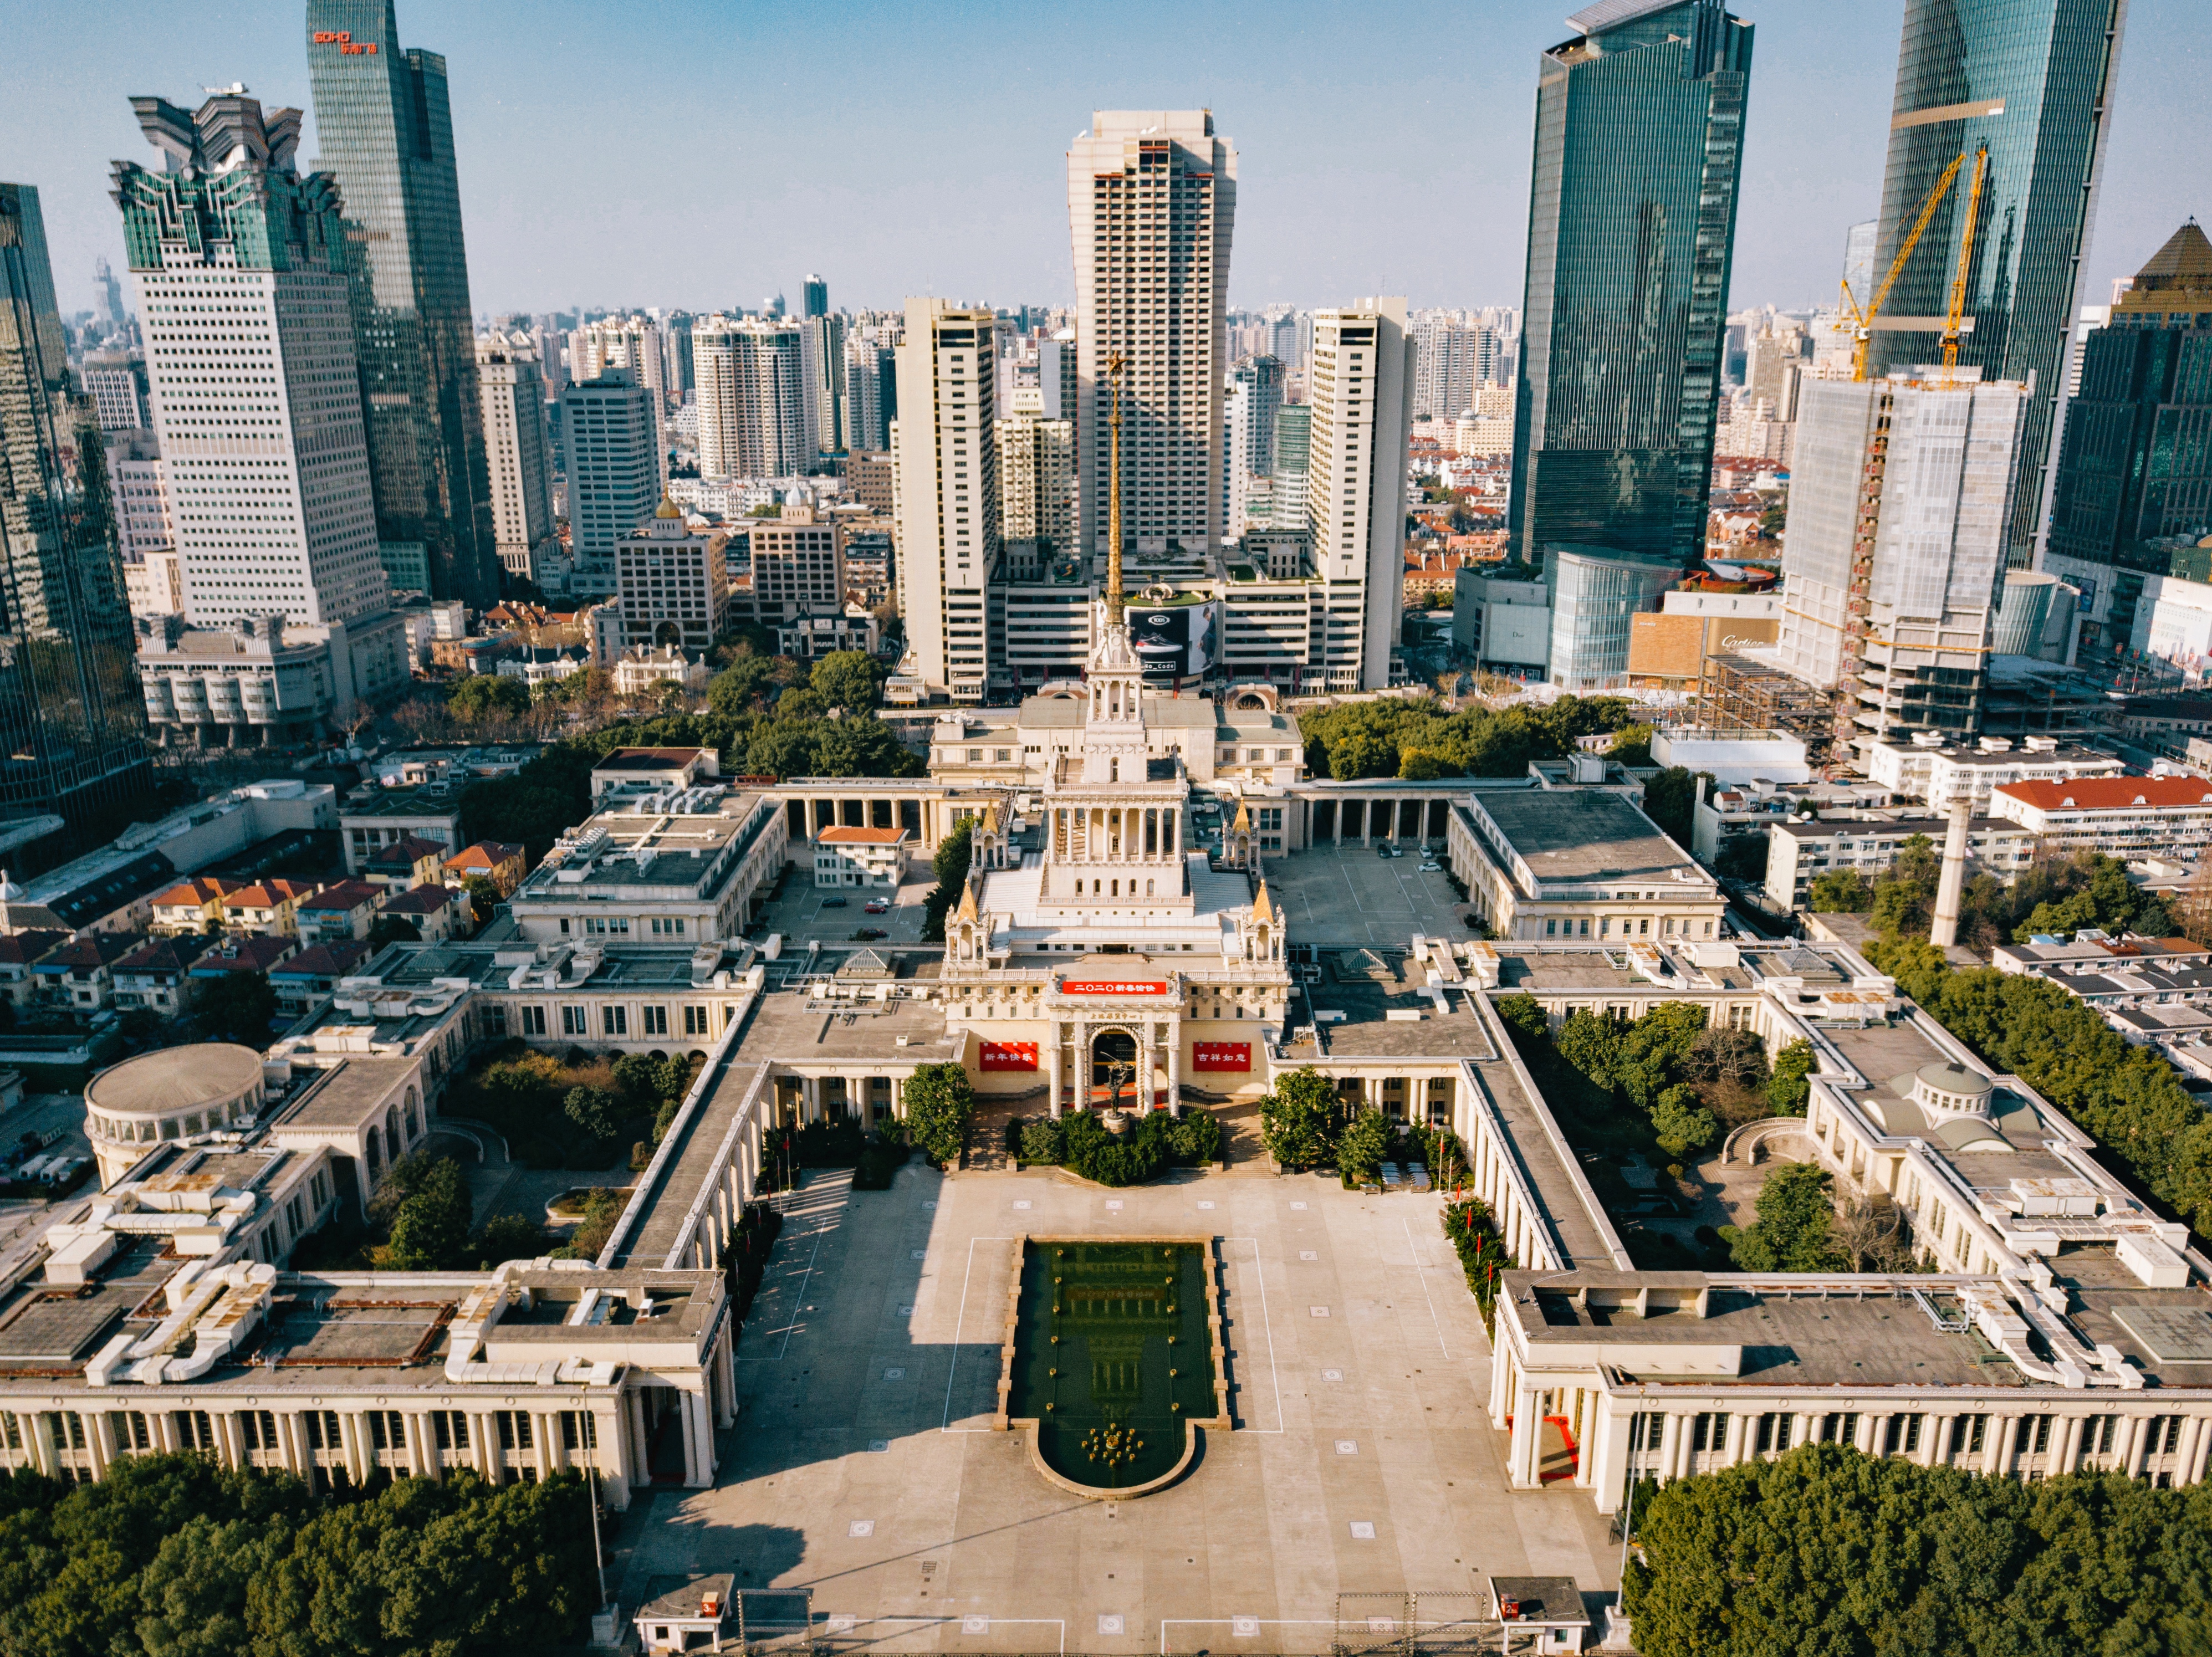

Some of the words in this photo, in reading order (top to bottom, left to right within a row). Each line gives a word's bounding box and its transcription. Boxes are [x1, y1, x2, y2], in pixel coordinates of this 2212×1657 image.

[314, 32, 350, 43] SOHO
[1721, 635, 1764, 647] Cartier
[984, 1052, 1034, 1062] 新年快乐
[1197, 1053, 1247, 1062] 吉祥如意
